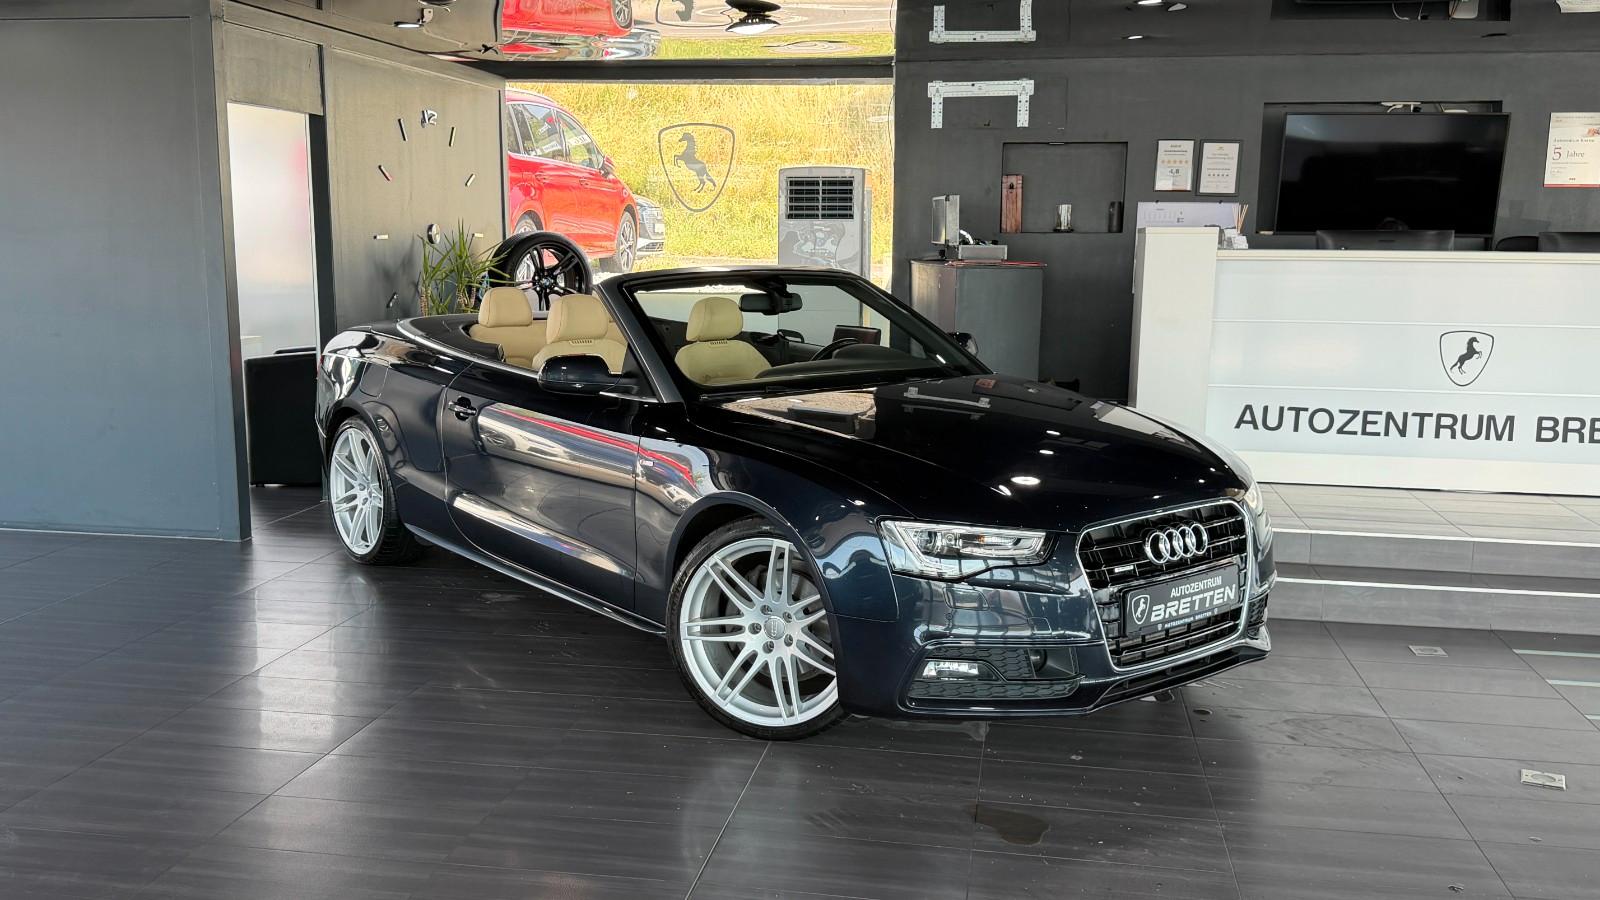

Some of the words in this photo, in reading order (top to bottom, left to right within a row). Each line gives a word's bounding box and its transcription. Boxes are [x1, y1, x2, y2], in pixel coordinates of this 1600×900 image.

[1552, 146, 1562, 161] 5
[1234, 403, 1515, 442] AUTOZENTRUM
[1535, 415, 1600, 444] BRE
[1170, 575, 1222, 598] AUTOZENTRUM
[1150, 583, 1236, 622] BRETTEN
